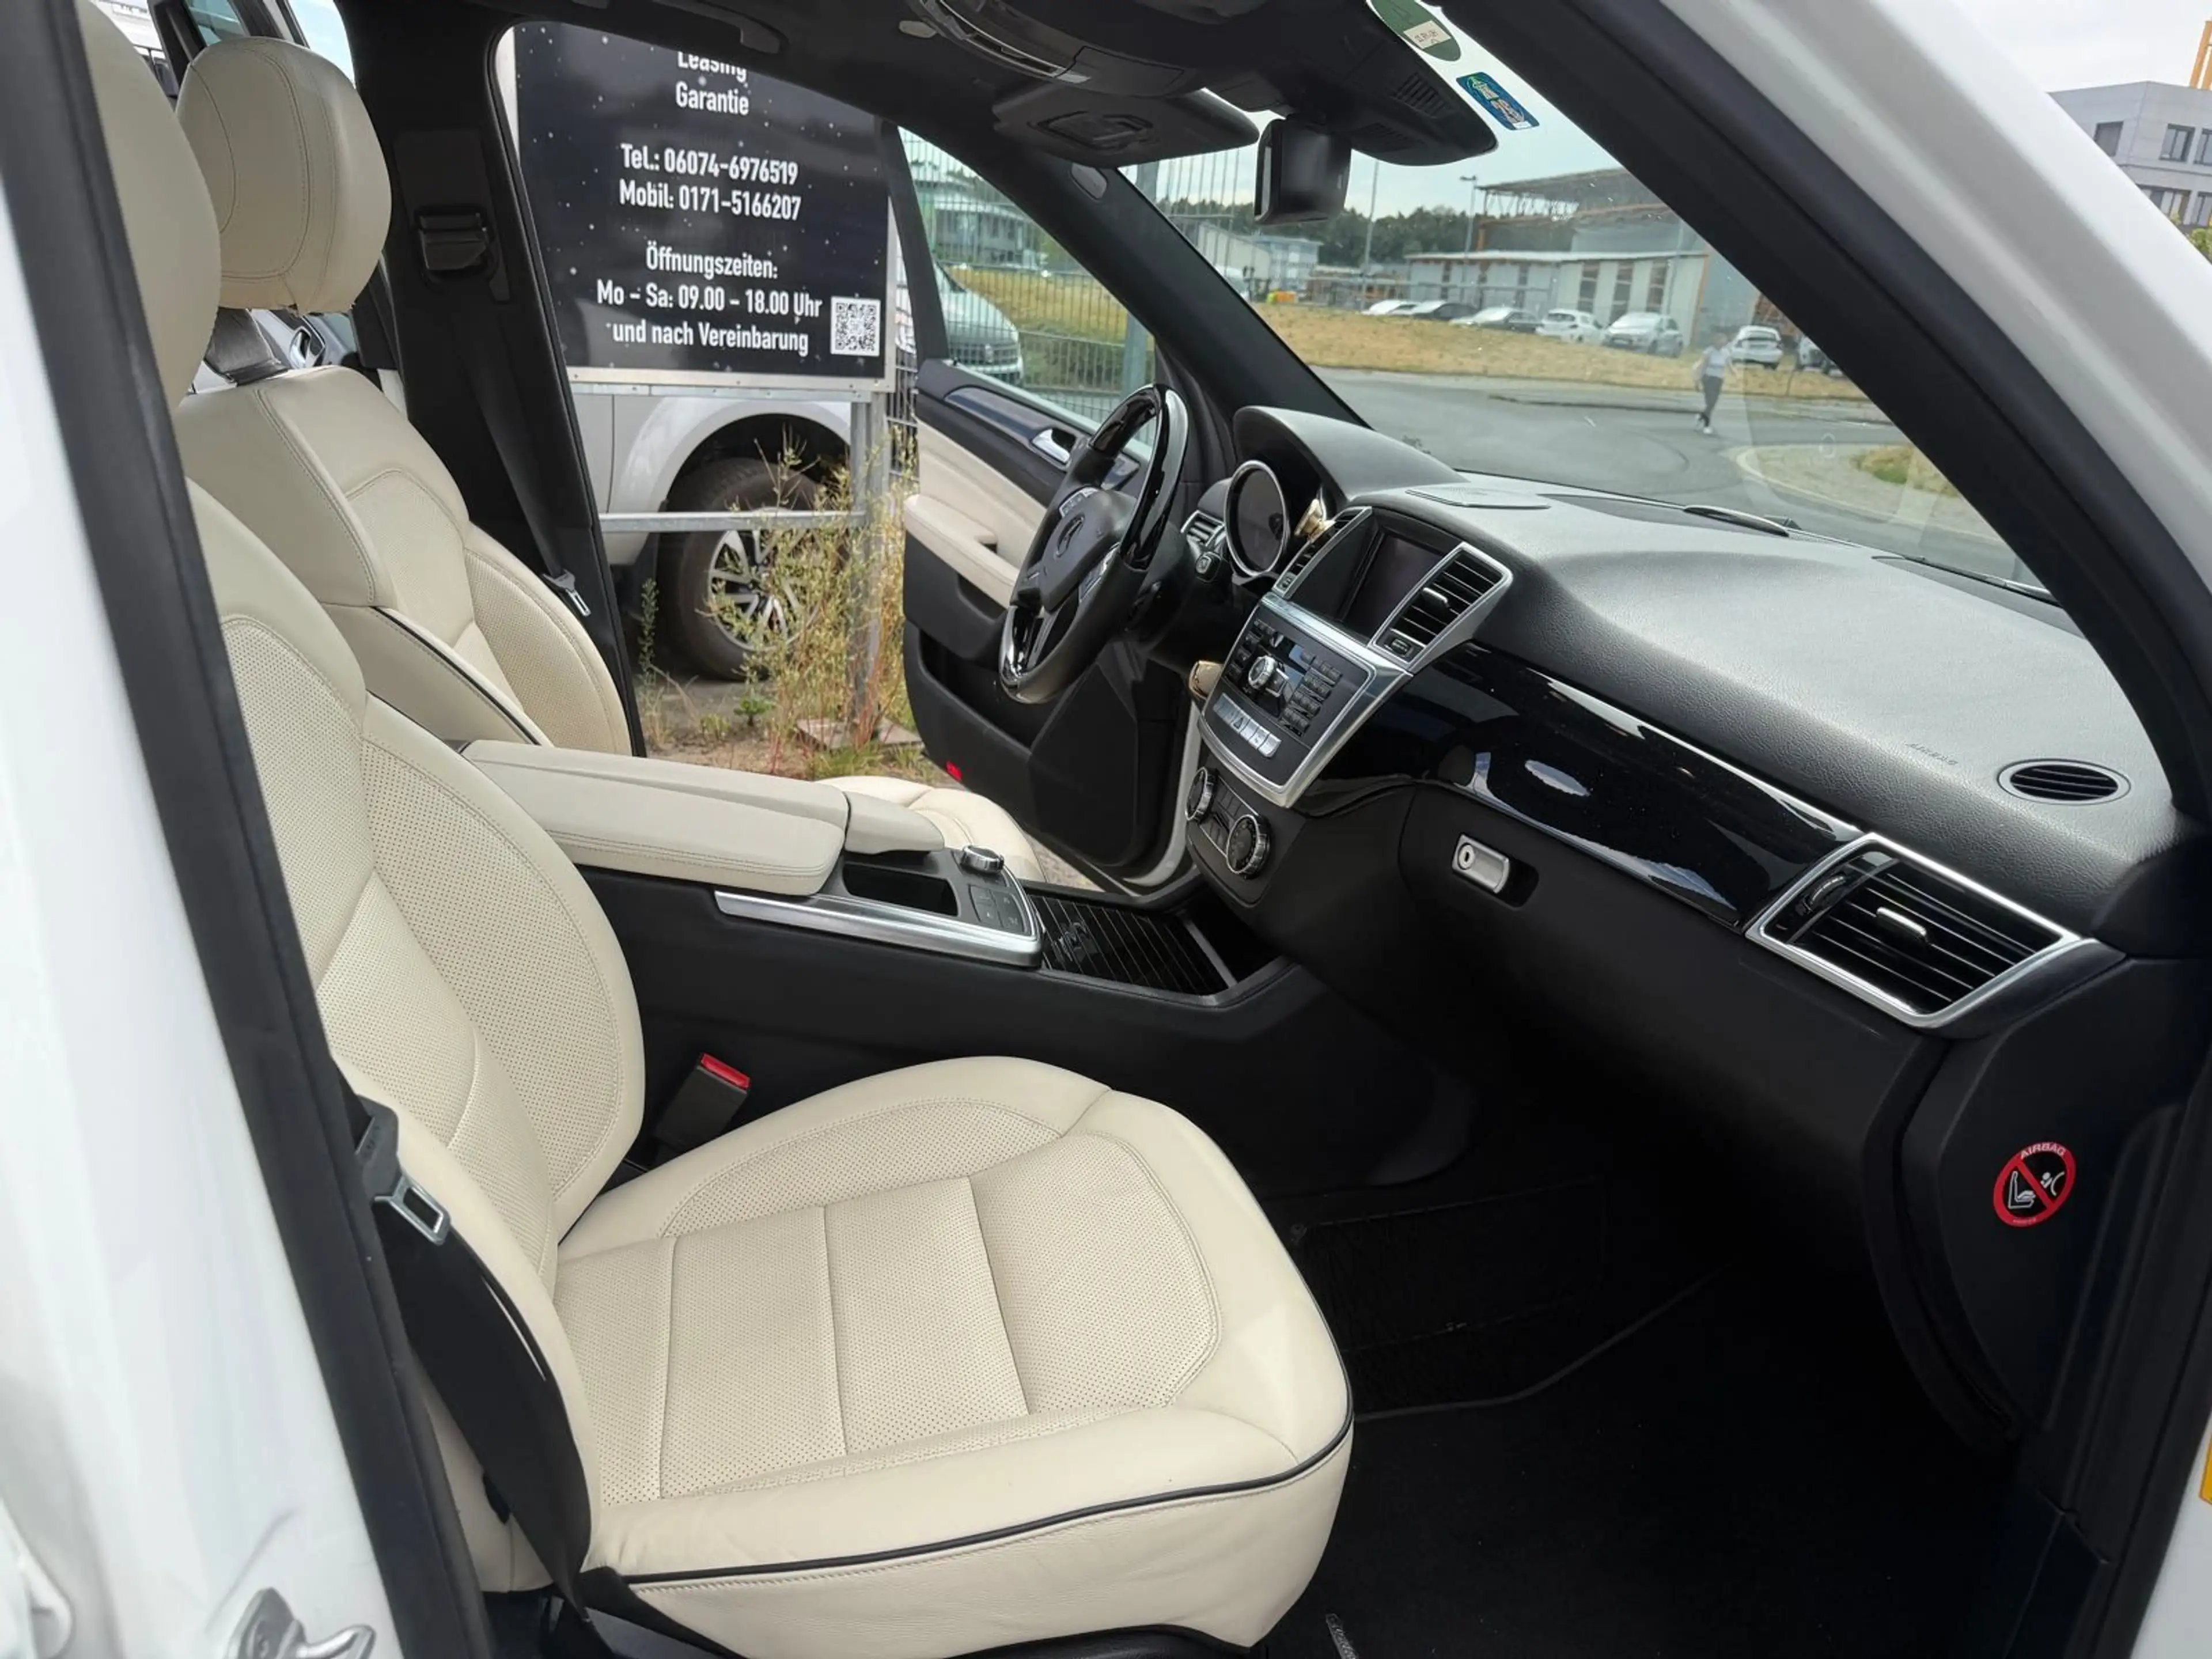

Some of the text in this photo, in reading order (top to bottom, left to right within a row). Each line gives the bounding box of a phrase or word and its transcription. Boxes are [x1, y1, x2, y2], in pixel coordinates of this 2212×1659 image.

[676, 81, 749, 115] Garantie
[620, 143, 798, 185] Tel.: 06074-6976519
[619, 178, 801, 221] Mobil: 0171-5166207
[646, 240, 778, 280] Öffnungszeiten:
[597, 278, 624, 305] Mo
[646, 282, 673, 308] Sa:
[678, 284, 725, 311] 09.00
[745, 289, 789, 315] 18.00
[793, 291, 823, 317] Uhr
[612, 319, 809, 357] und nach Vereinbarung
[2020, 1142, 2066, 1159] AIRBAG
